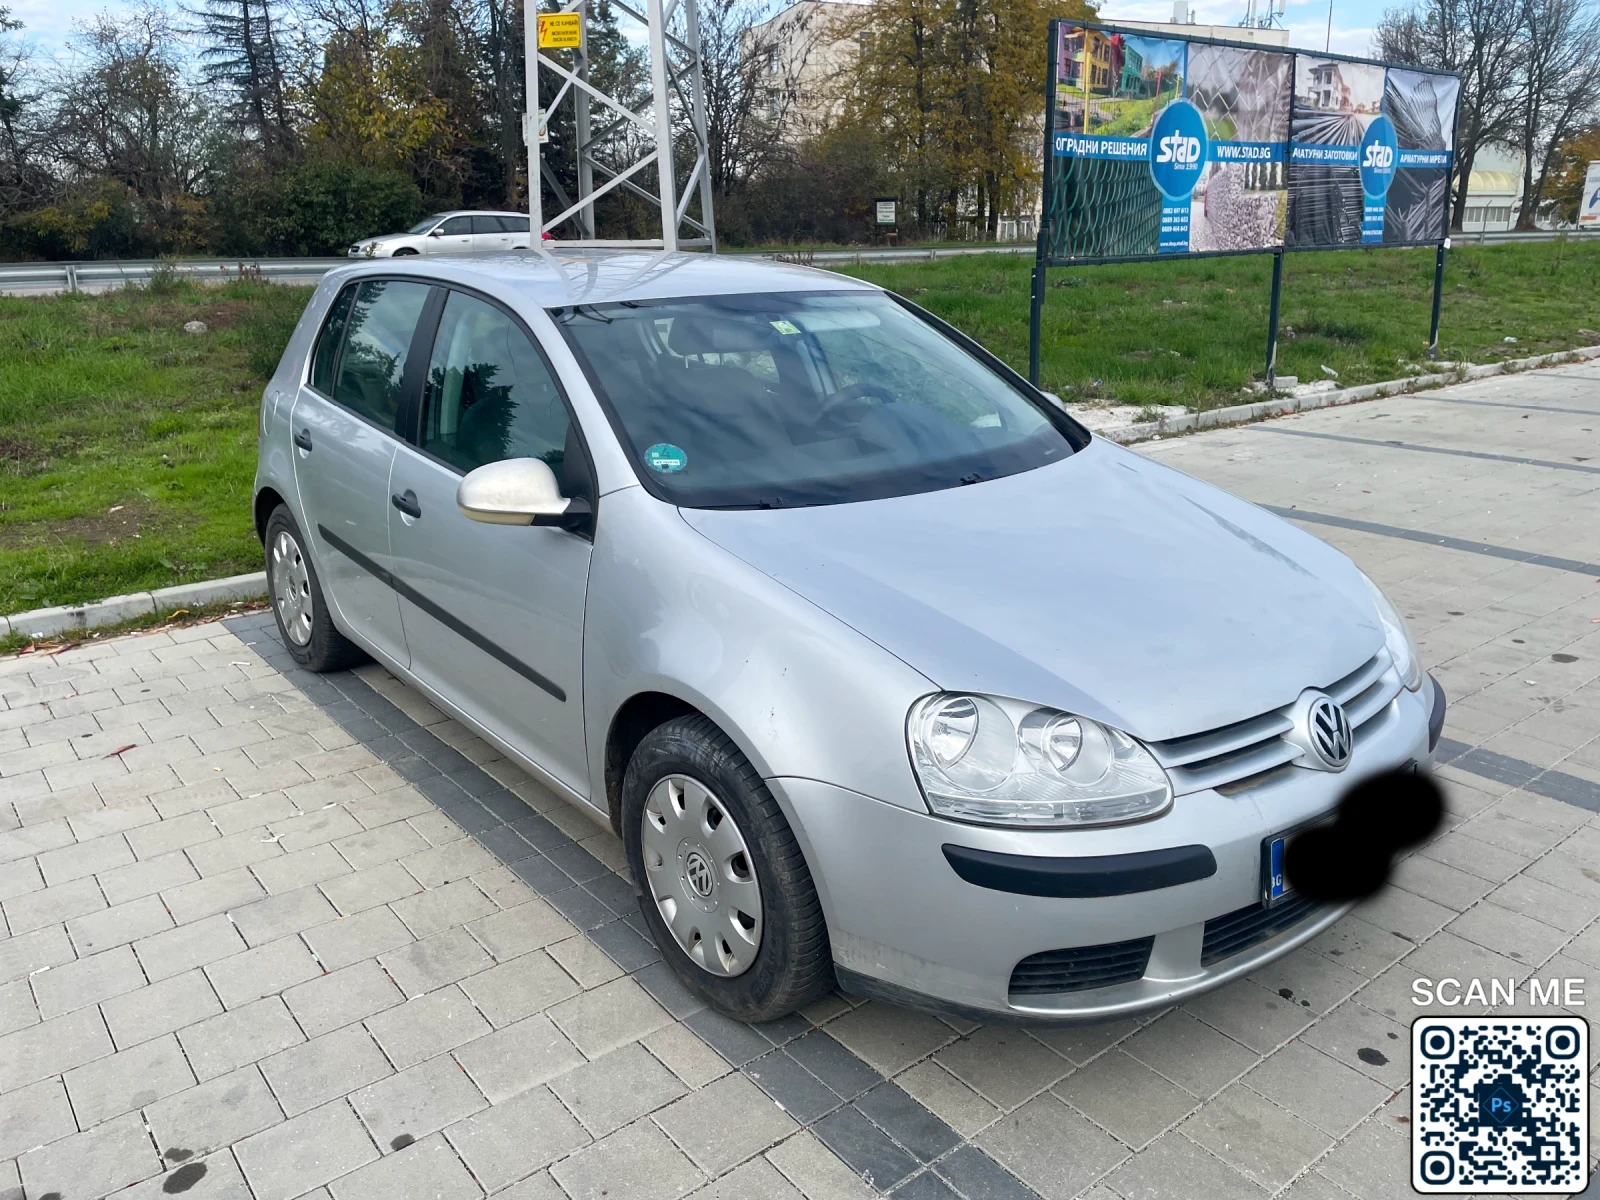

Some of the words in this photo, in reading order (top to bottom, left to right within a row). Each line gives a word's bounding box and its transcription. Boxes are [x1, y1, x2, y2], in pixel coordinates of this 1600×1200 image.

[1055, 137, 1099, 156] ОГРАДНИ
[1101, 140, 1148, 156] РЕШЕНИЯ
[1216, 145, 1271, 159] WWW.STAD.BG
[1323, 149, 1358, 161] ЗАГОТОВКИ
